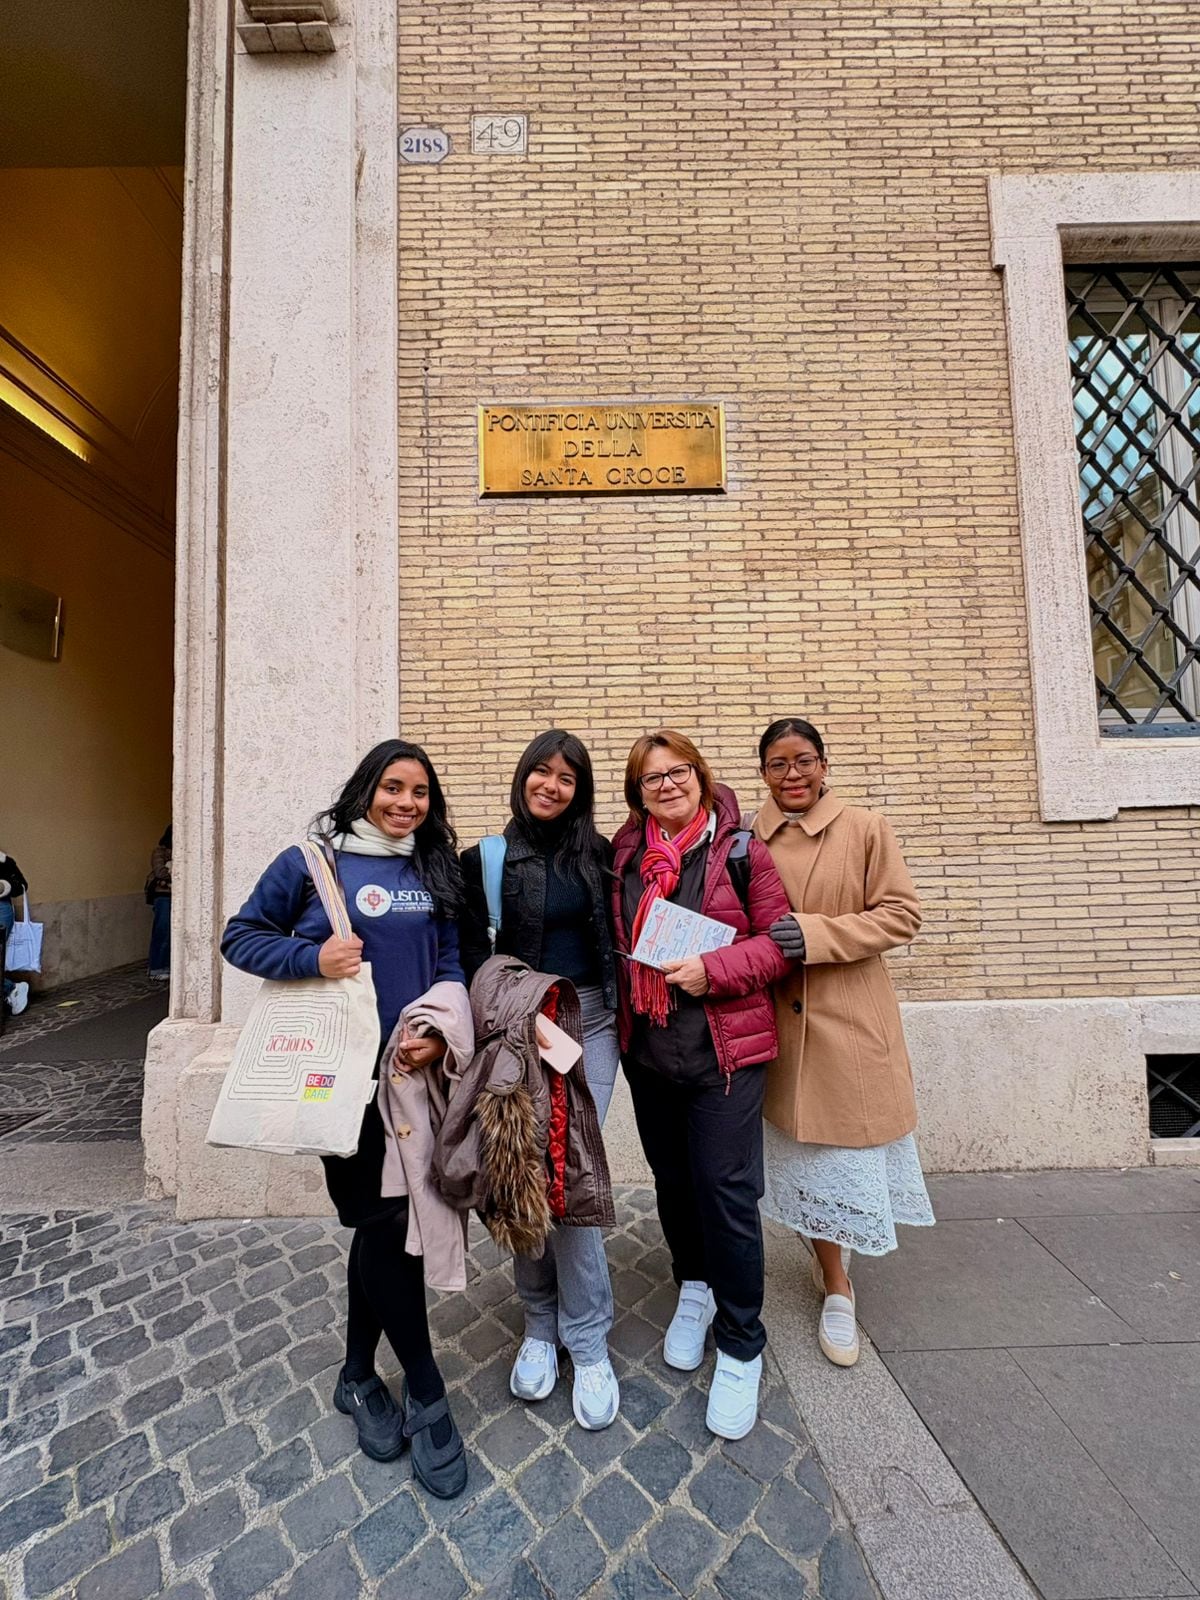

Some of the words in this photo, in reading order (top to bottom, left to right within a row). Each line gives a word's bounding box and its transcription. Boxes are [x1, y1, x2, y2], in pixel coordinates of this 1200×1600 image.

[476, 119, 522, 148] 49
[403, 137, 443, 153] 2188
[487, 412, 600, 432] PONTIFICIA
[605, 411, 716, 431] UNIVERSITA
[564, 440, 642, 458] DELLA
[520, 467, 593, 486] SANTA
[606, 465, 686, 485] CROCE
[390, 889, 433, 902] usma
[303, 1088, 329, 1100] CARE
